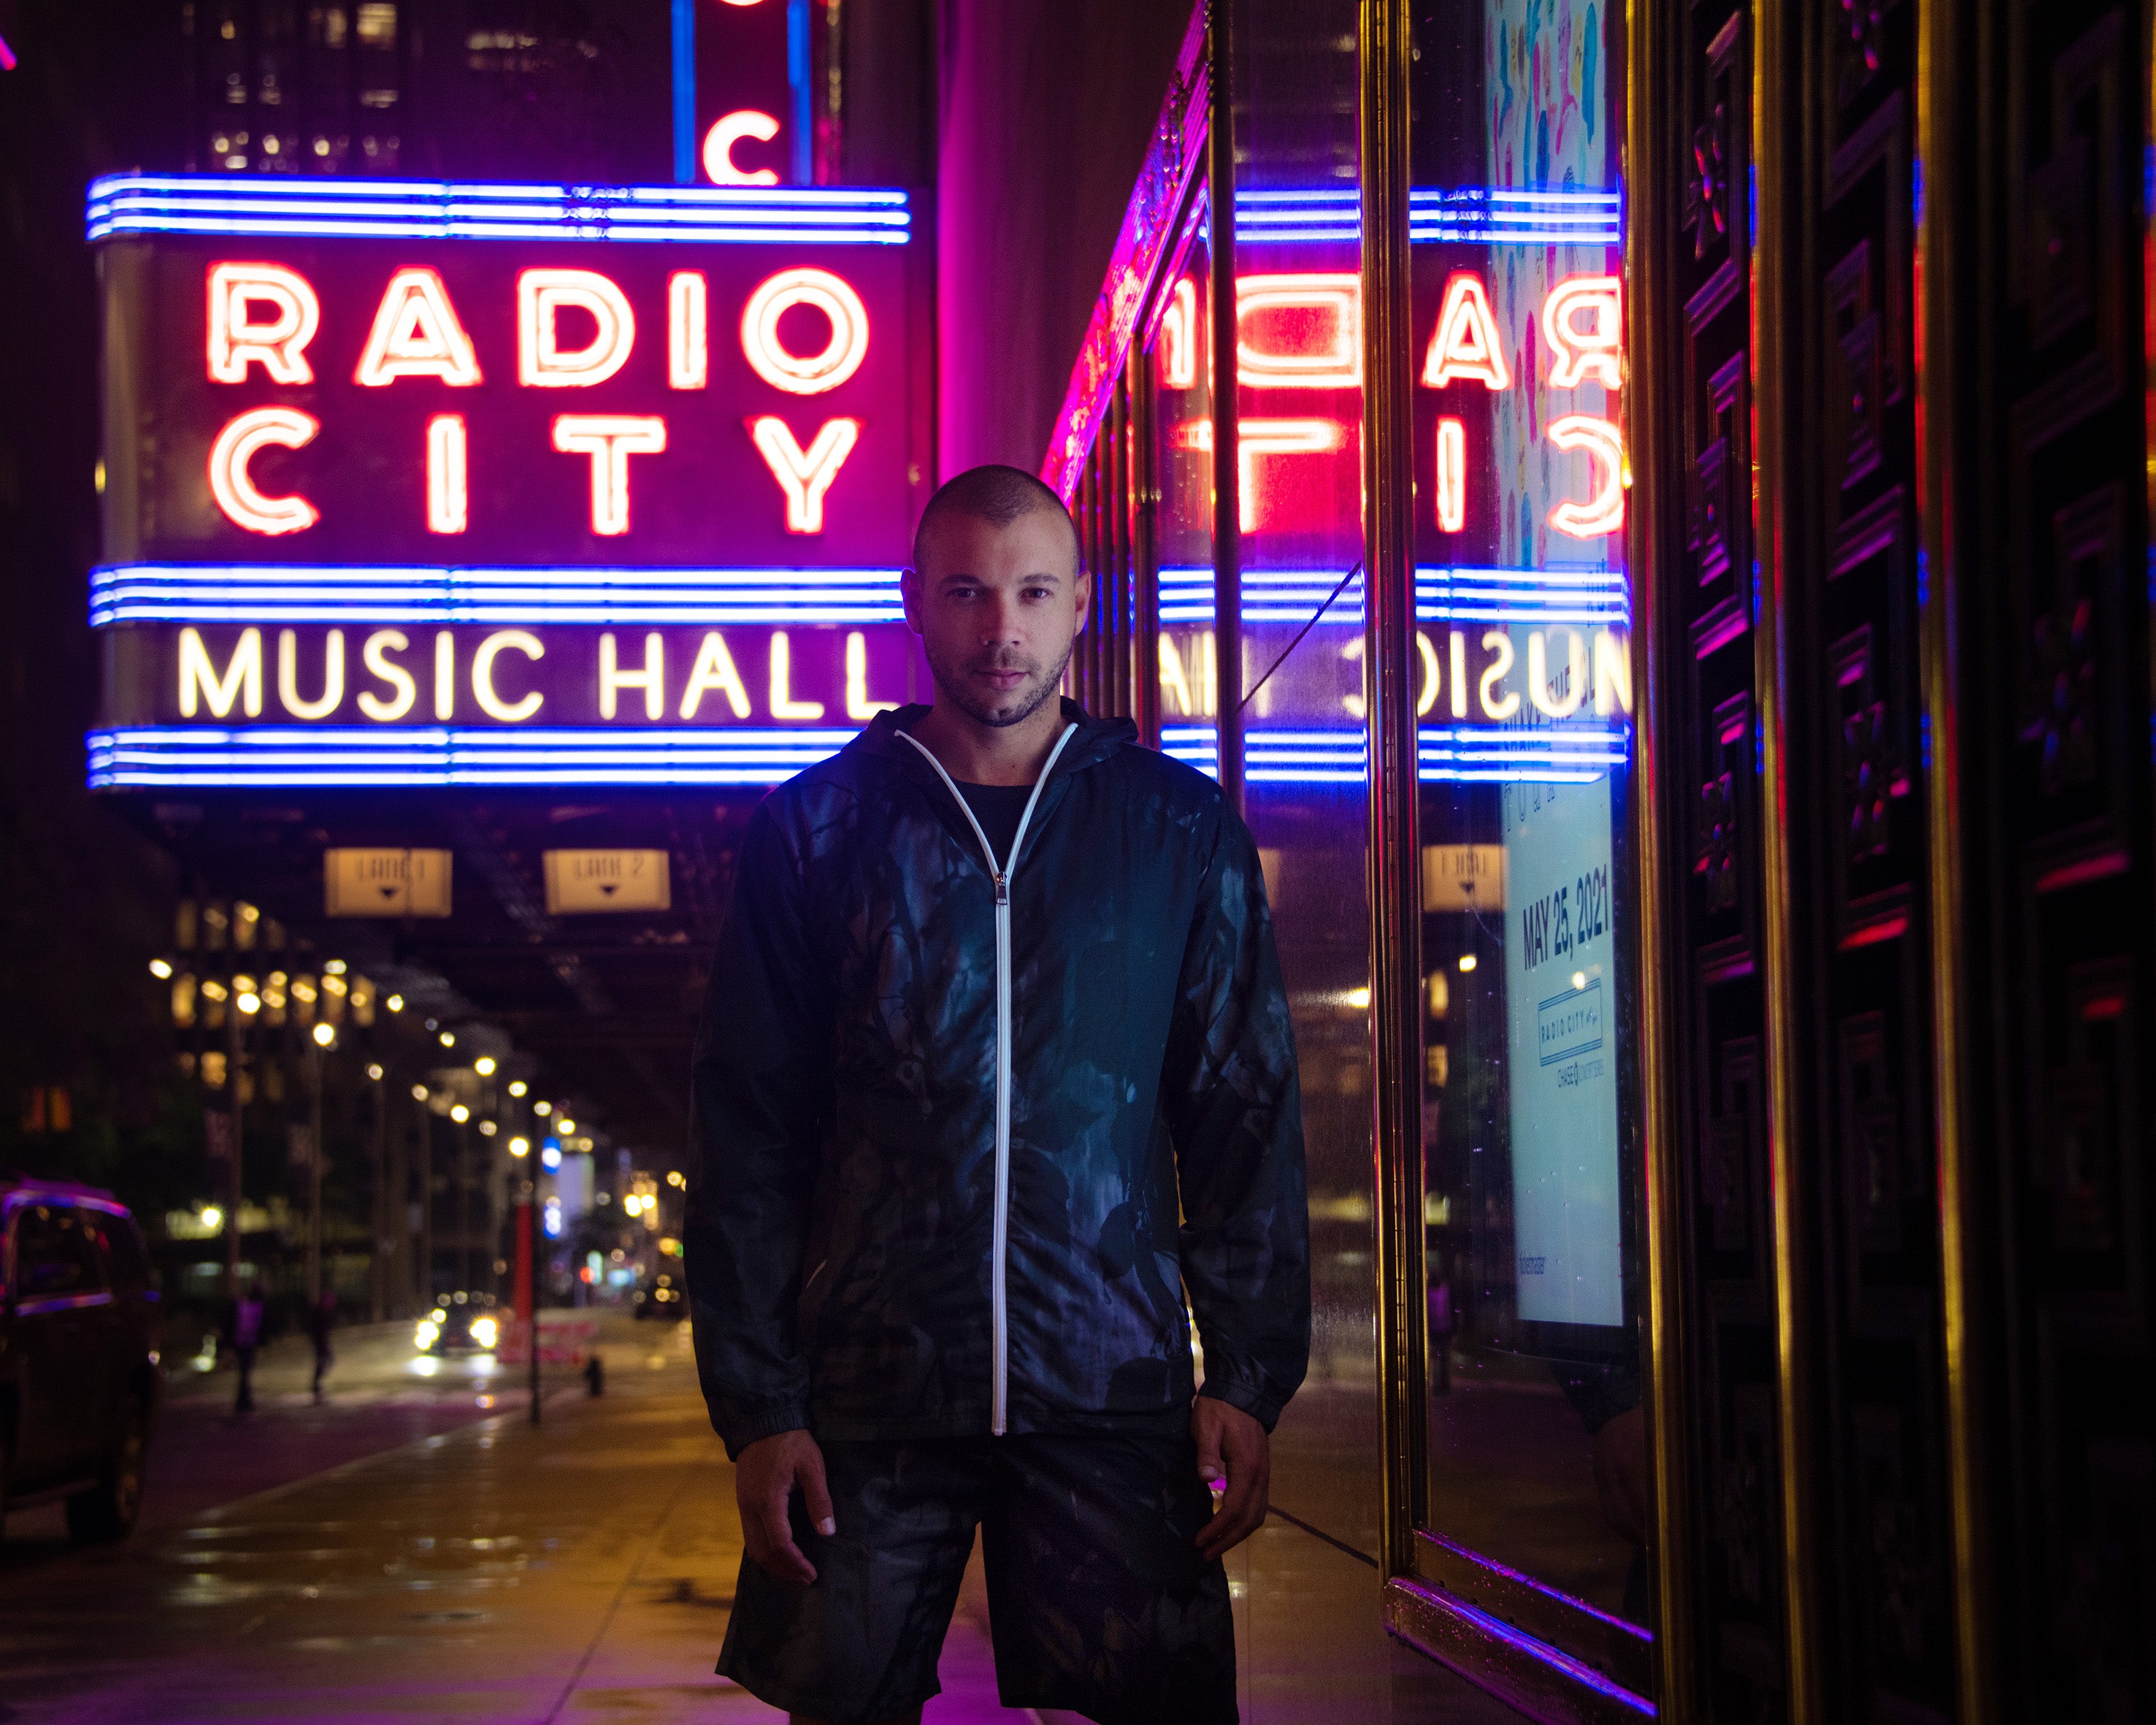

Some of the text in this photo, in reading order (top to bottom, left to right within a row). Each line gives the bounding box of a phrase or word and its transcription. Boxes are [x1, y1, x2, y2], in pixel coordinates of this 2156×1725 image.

[207, 262, 870, 394] RADIO
[207, 406, 862, 535] CITY
[177, 627, 902, 721] MUSIC HALL
[1523, 863, 1608, 971] MAY 25, 2021
[1541, 1009, 1584, 1044] RADIO CITY
